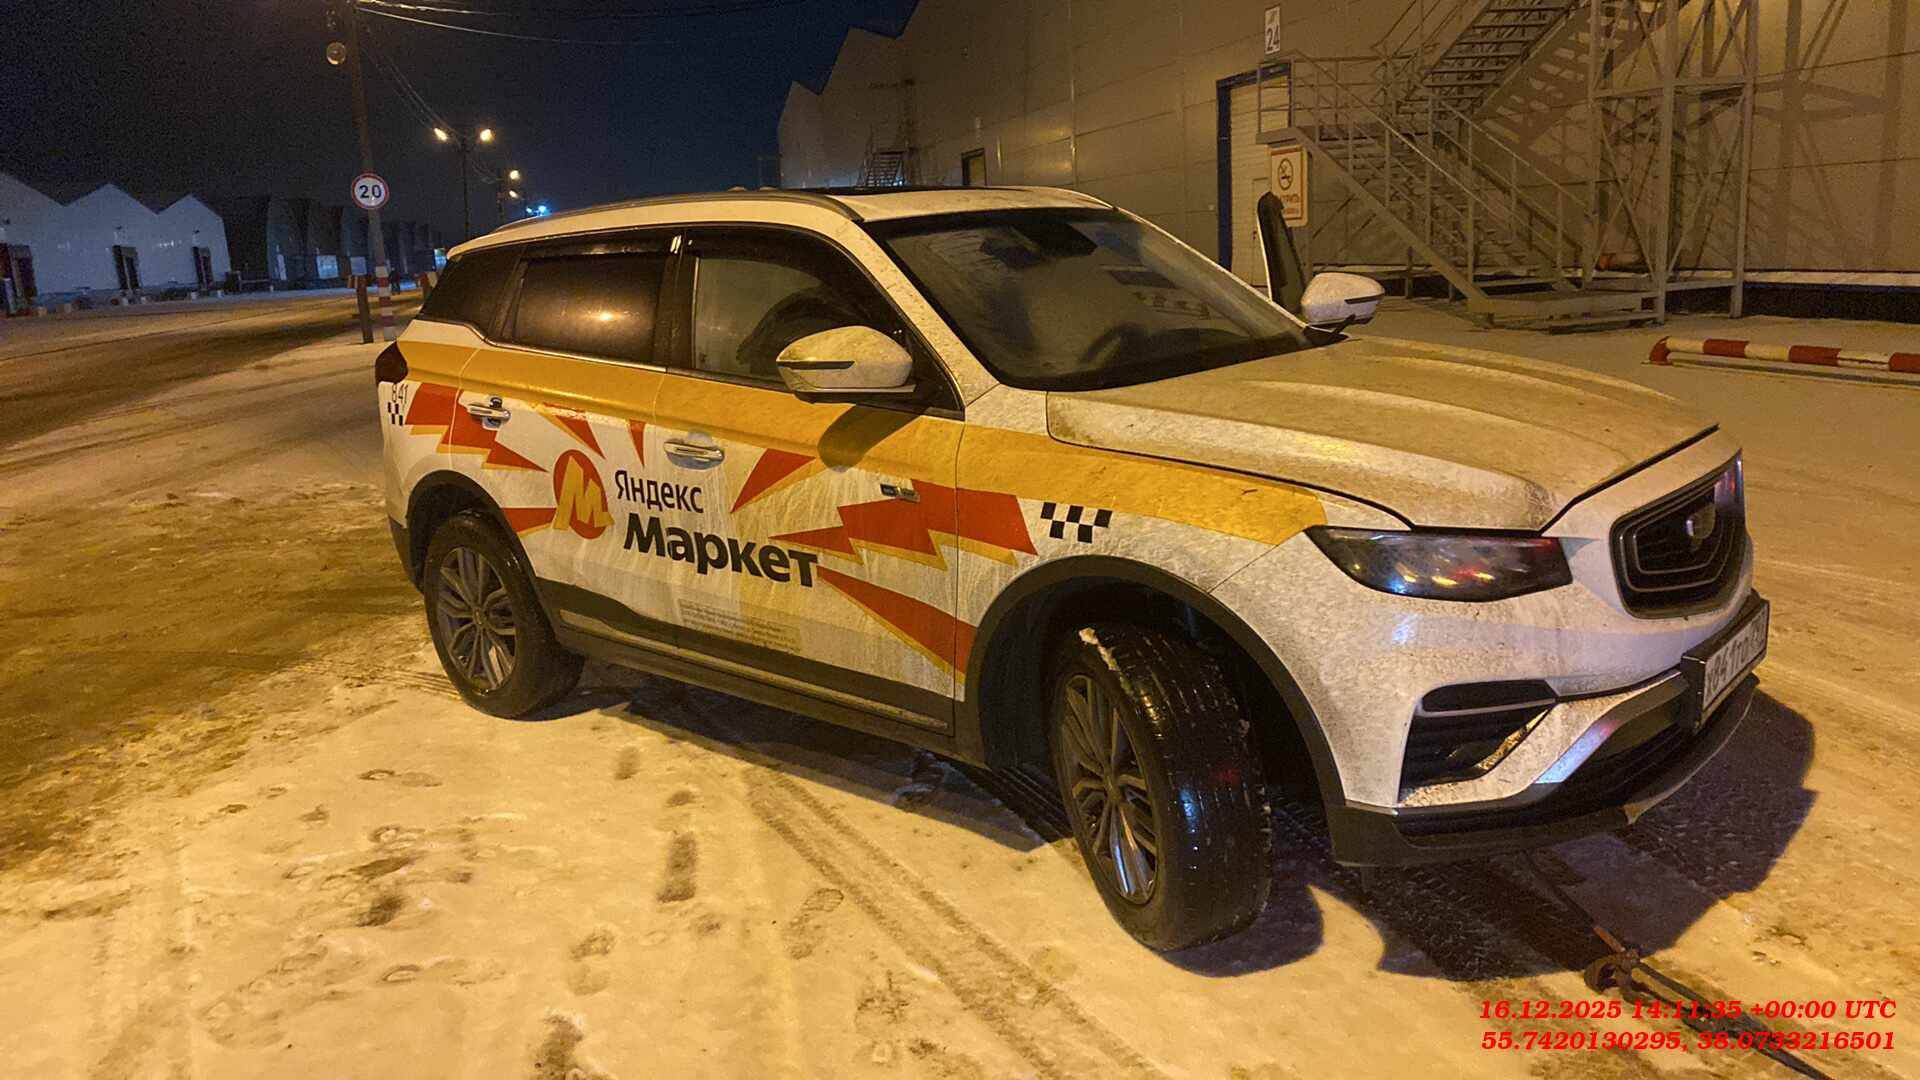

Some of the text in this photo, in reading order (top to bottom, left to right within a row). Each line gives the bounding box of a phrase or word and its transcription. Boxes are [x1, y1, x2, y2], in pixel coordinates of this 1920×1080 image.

[1267, 25, 1280, 51] 24
[359, 184, 383, 198] 20
[392, 383, 408, 404] 841
[614, 469, 704, 514] Яндекс
[623, 512, 819, 588] Маркет
